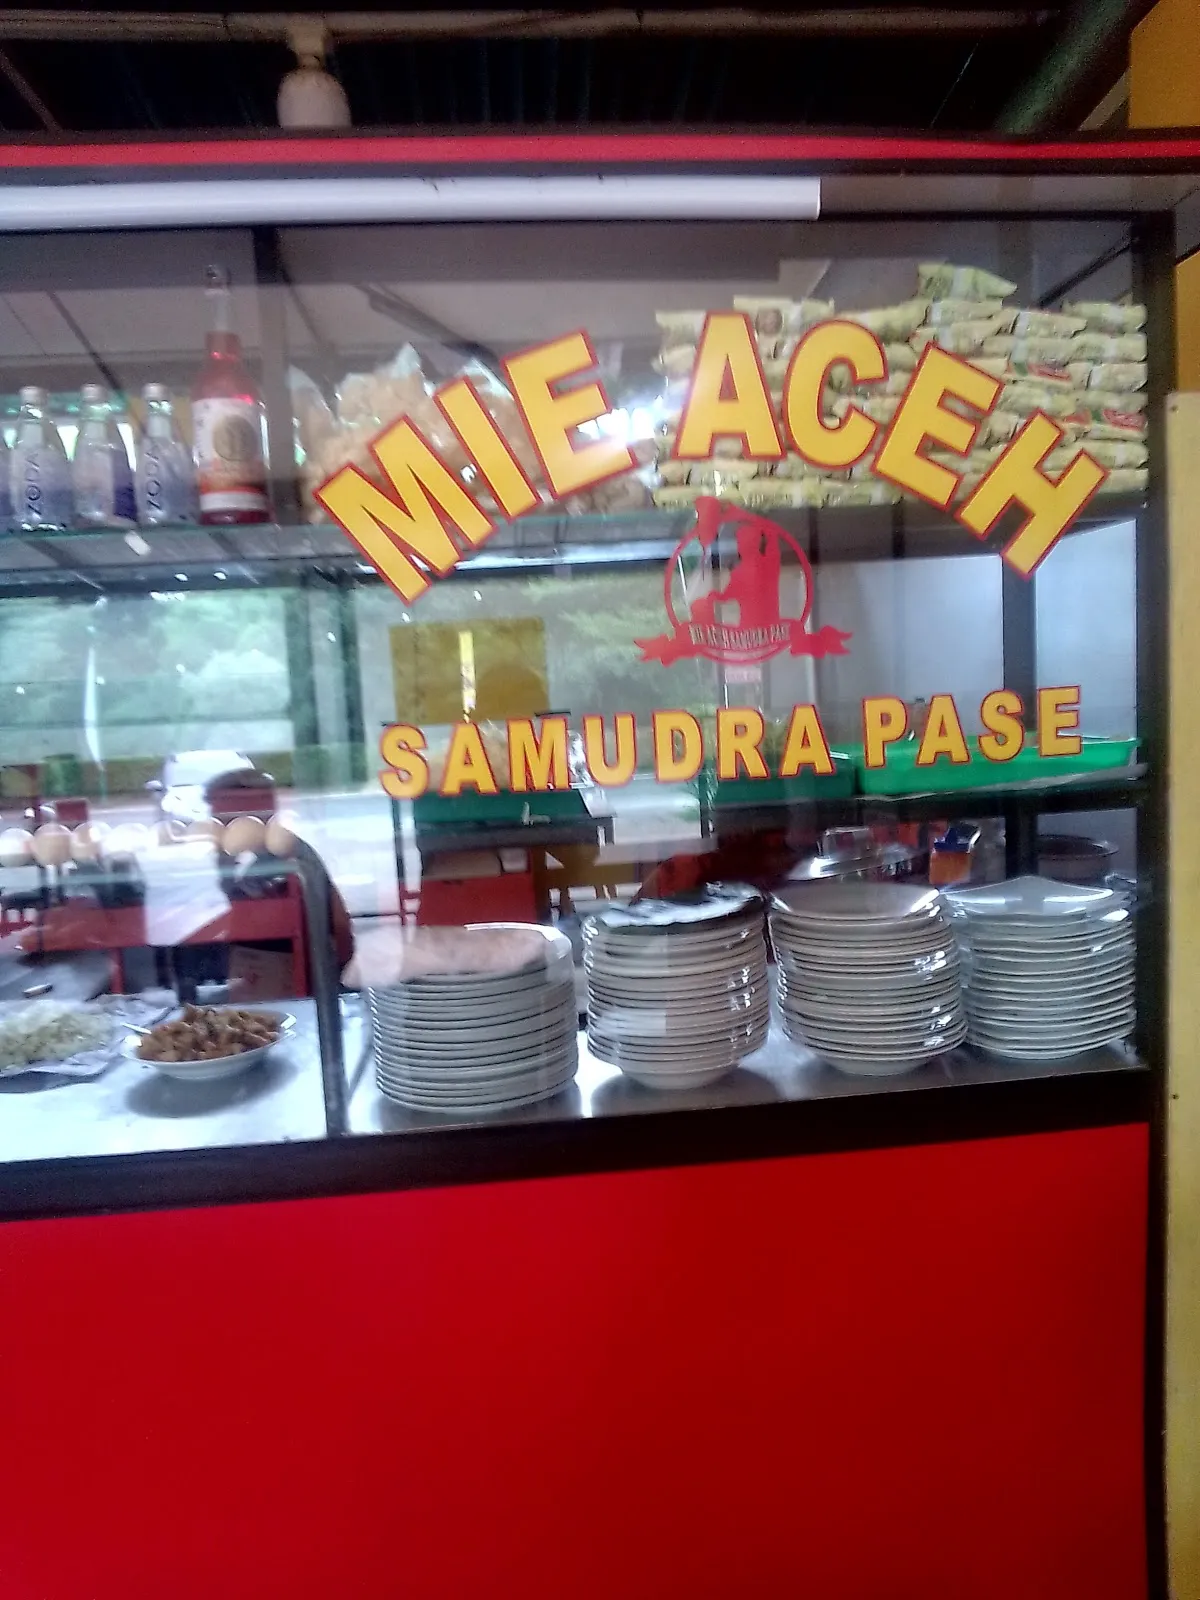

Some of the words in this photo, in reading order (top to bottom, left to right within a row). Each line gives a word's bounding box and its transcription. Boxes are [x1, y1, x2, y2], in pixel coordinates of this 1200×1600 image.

[312, 329, 638, 607] MIE
[671, 310, 1107, 581] ACEH
[379, 703, 834, 799] SAMUDRA
[862, 685, 1082, 769] PASE
